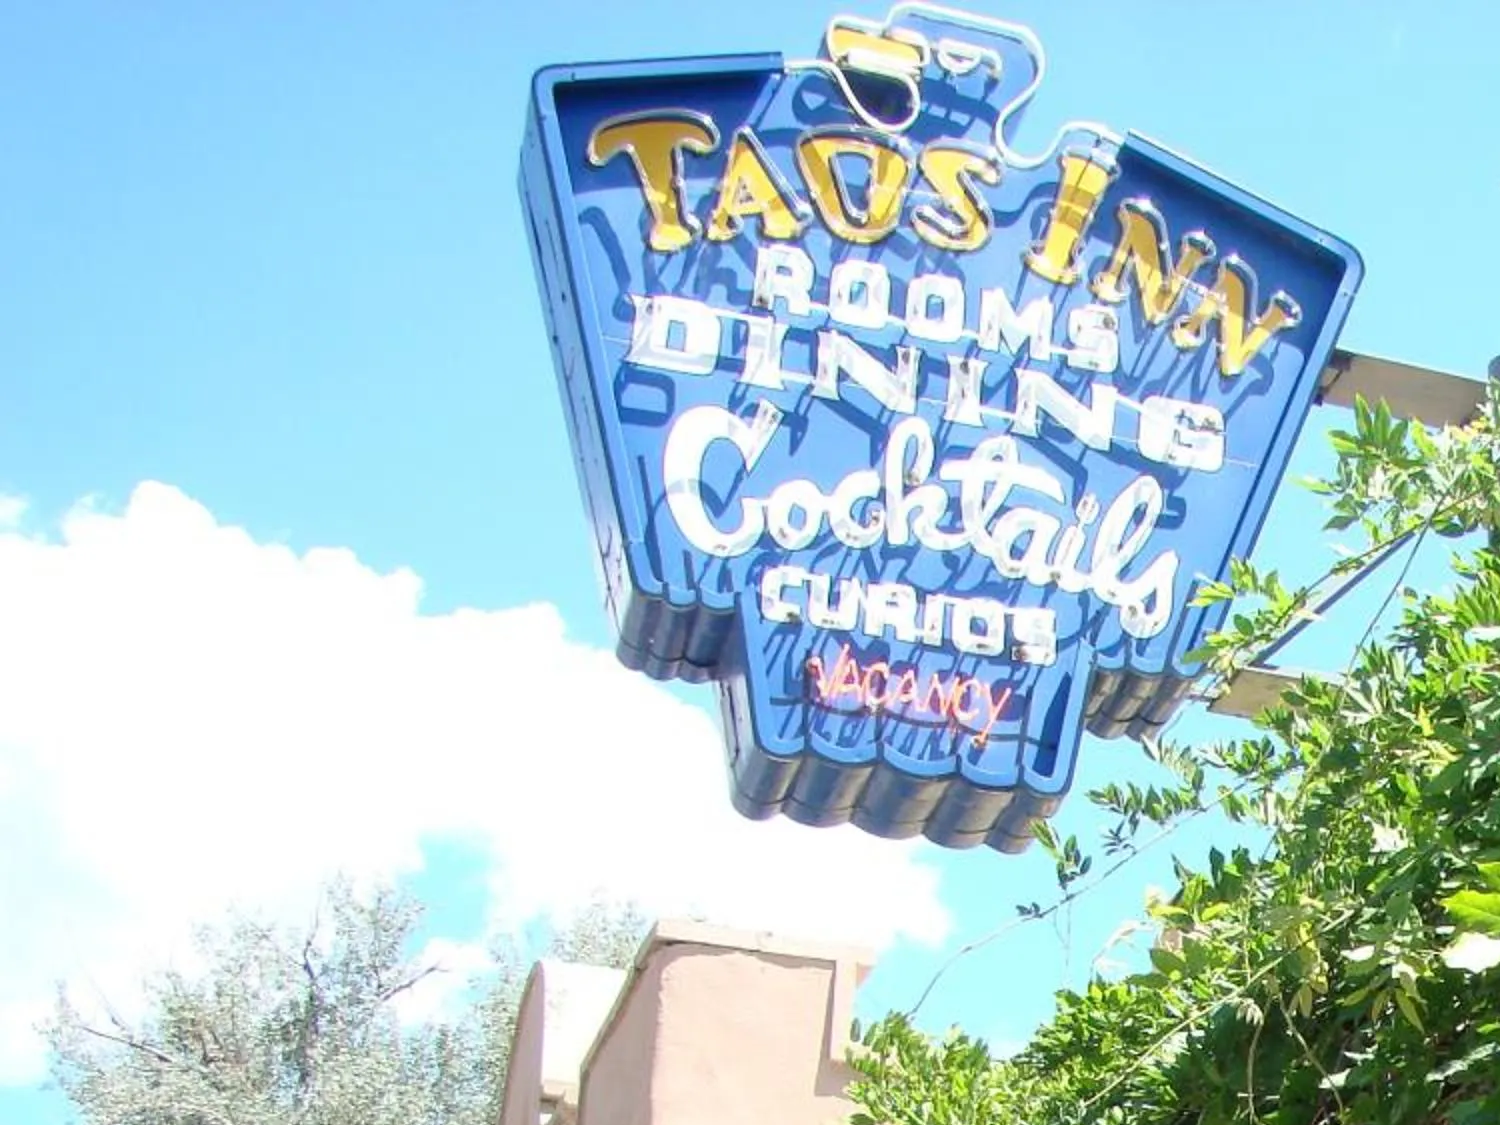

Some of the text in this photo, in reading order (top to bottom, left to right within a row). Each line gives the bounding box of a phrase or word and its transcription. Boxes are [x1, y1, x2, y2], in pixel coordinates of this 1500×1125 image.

[586, 109, 1302, 376] TAOS INN
[752, 245, 1120, 373] ROOMS
[625, 293, 1228, 472] DINING
[662, 399, 1181, 638] Cocktails
[759, 565, 1058, 667] CURIOS
[807, 643, 1011, 749] VACANCY
